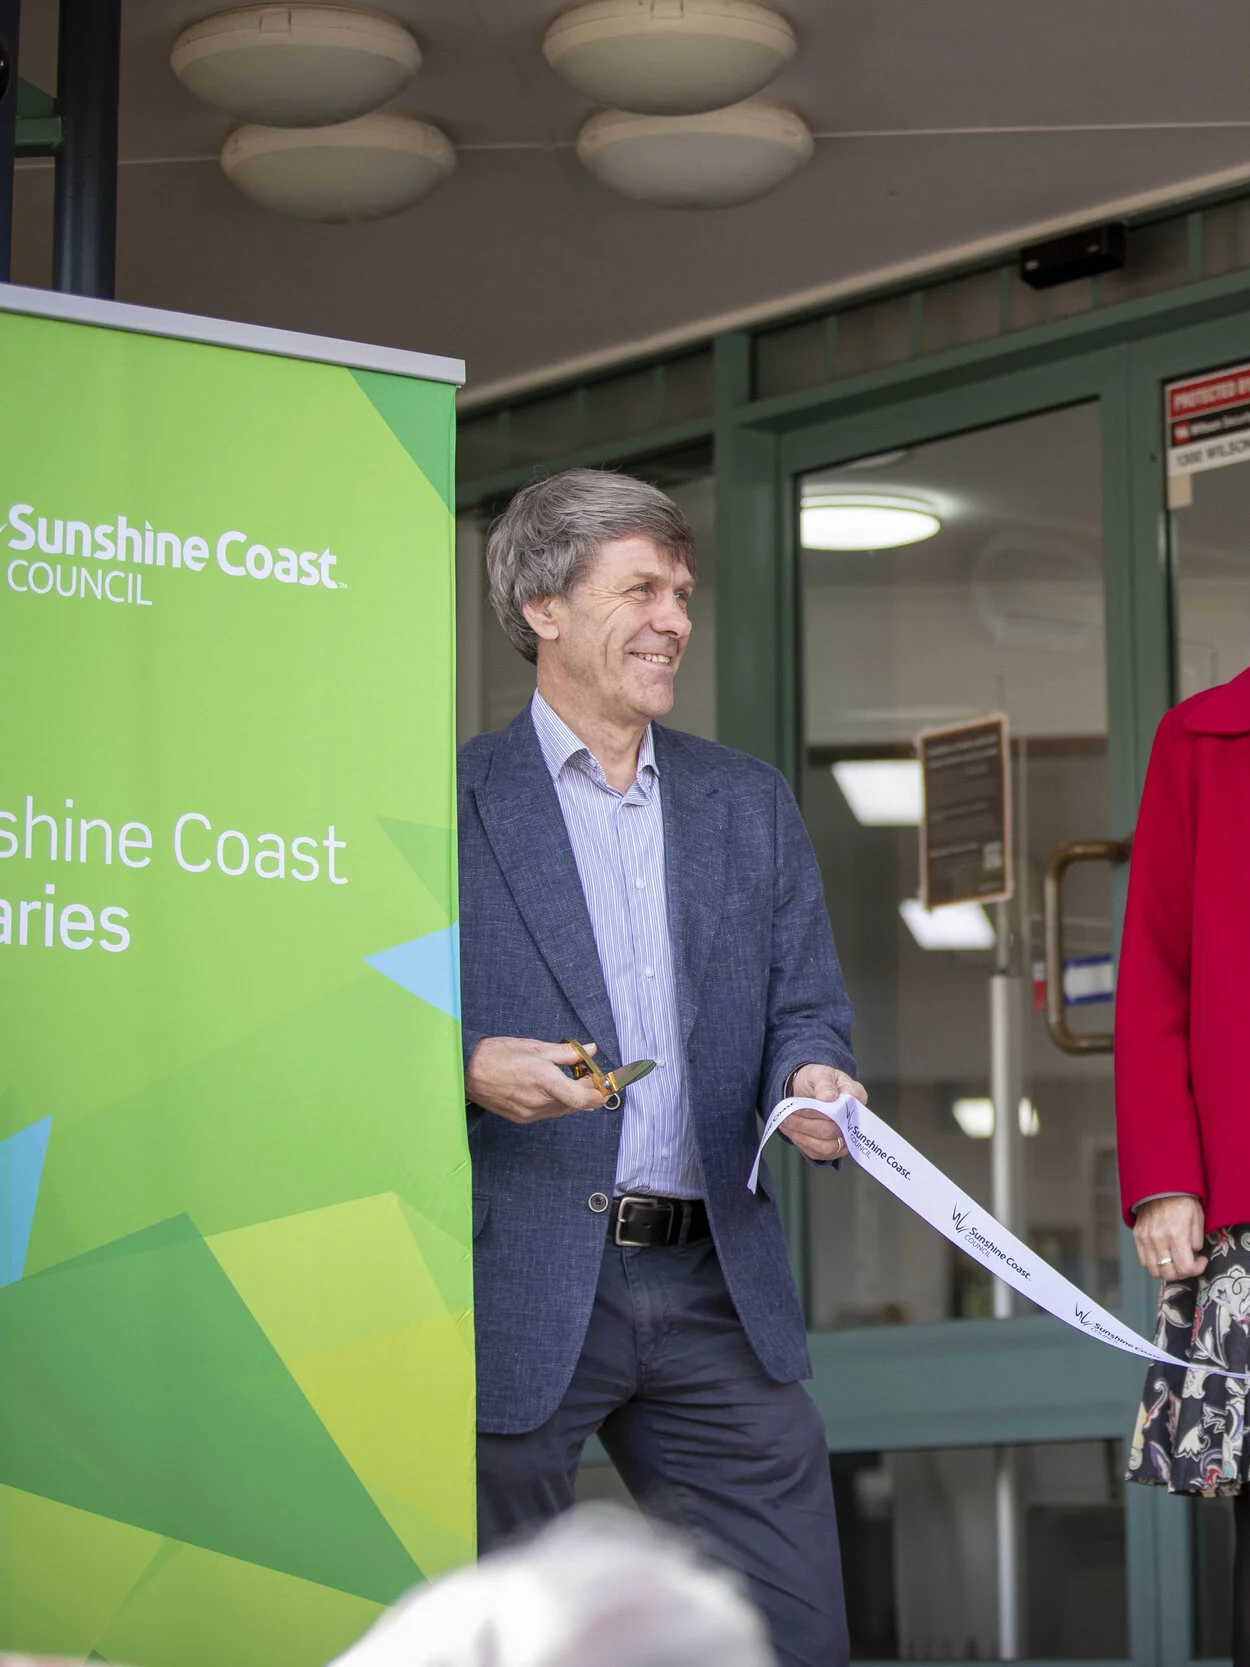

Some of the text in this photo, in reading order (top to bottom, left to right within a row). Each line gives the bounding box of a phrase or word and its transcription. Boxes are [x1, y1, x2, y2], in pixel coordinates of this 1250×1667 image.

[8, 504, 209, 572] Sunshine
[216, 530, 339, 589] Coast
[7, 559, 153, 606] COUNCIL
[174, 811, 349, 885] Coast
[850, 1133, 871, 1158] COUNCIL
[852, 1125, 911, 1179] Sunshine Coast
[964, 1234, 991, 1258] COUNCIL
[969, 1227, 1031, 1279] Sunshine Coast
[1093, 1323, 1134, 1347] Sunshine
